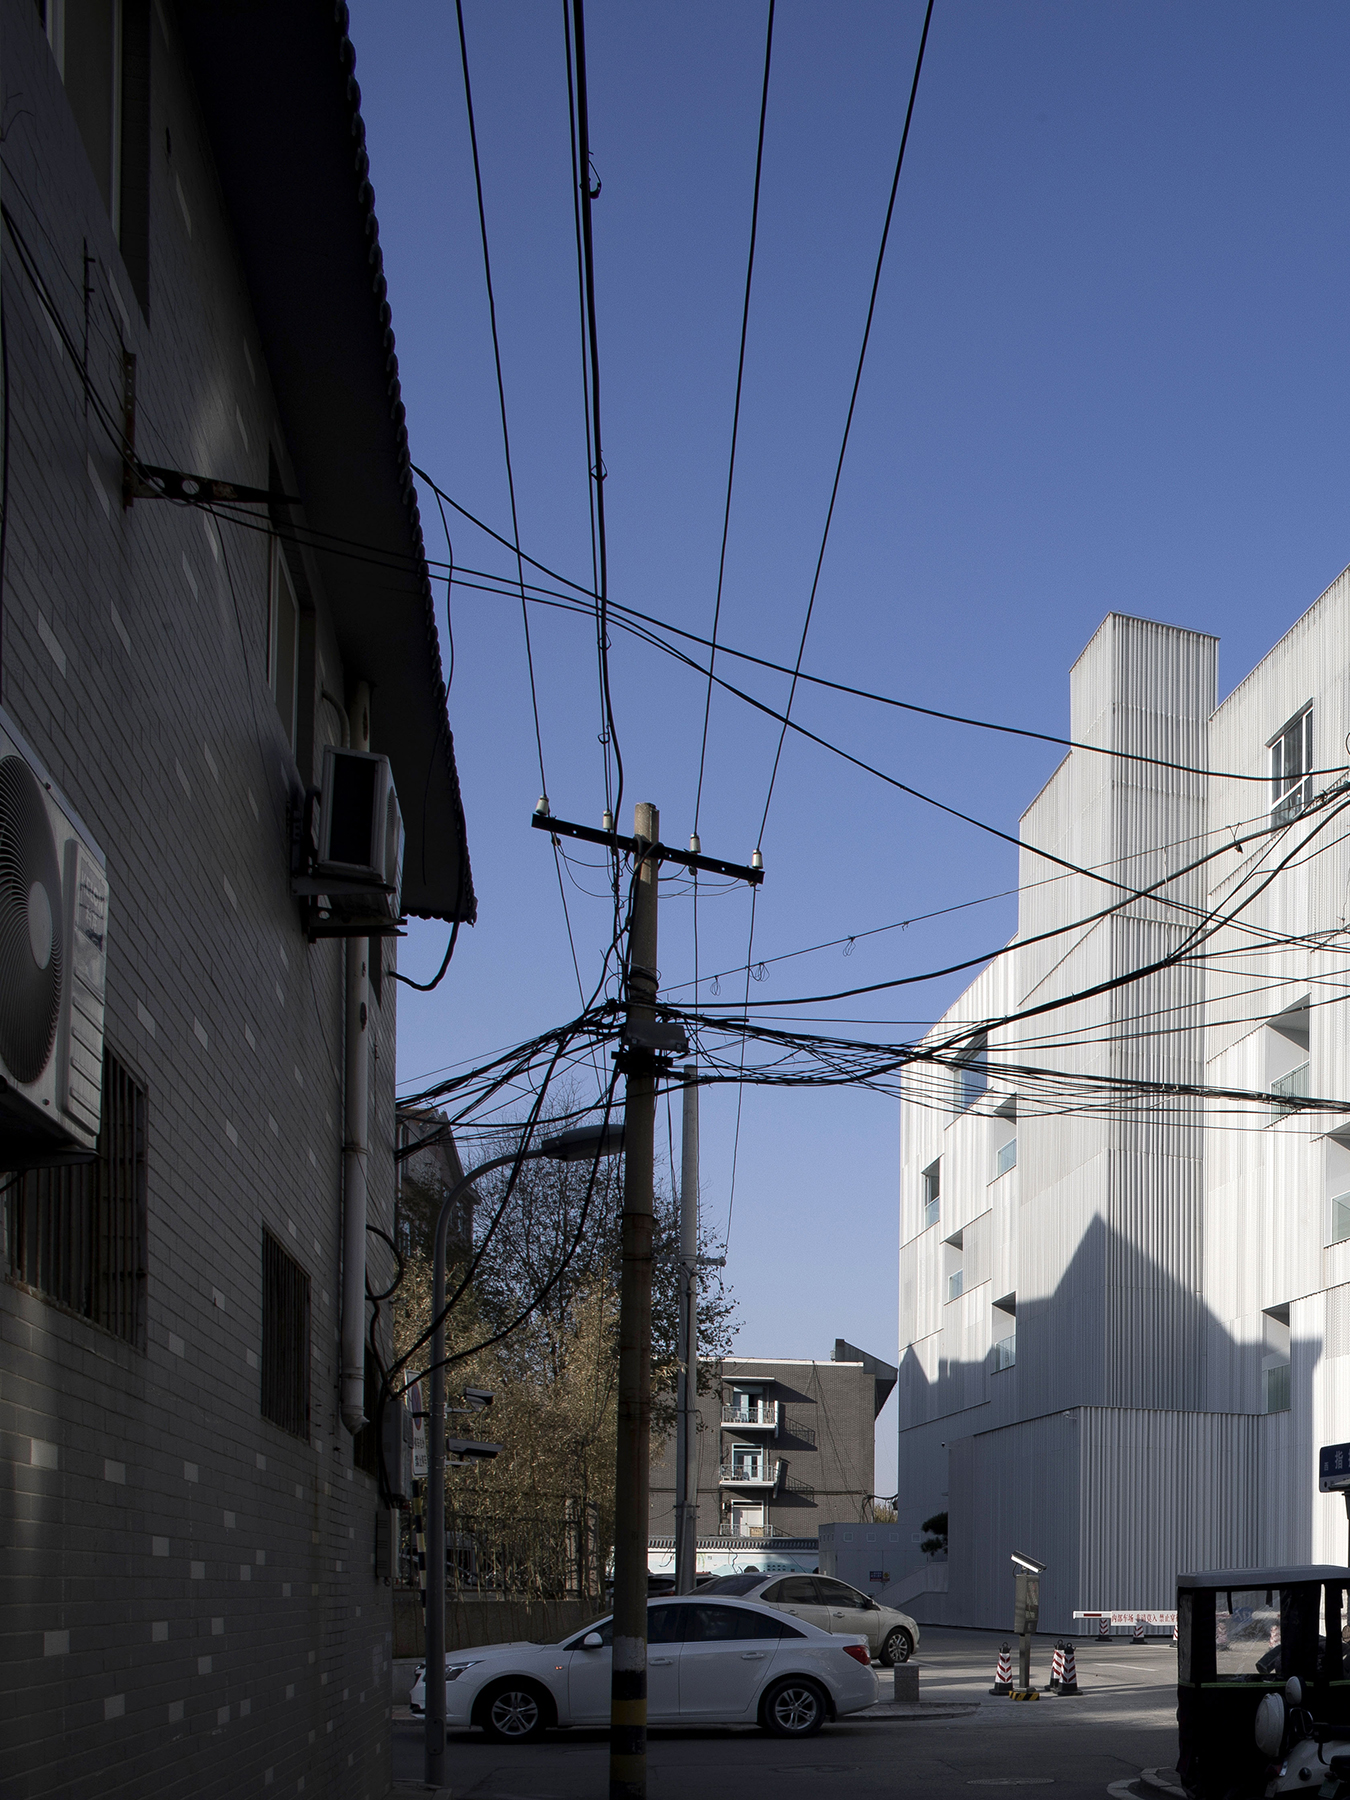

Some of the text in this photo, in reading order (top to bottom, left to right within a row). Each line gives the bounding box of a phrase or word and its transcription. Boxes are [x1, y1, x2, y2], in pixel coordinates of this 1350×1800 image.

[1323, 1461, 1329, 1471] 西
[1111, 1613, 1134, 1623] 内部车场
[1159, 1613, 1179, 1623] 禁止穿
